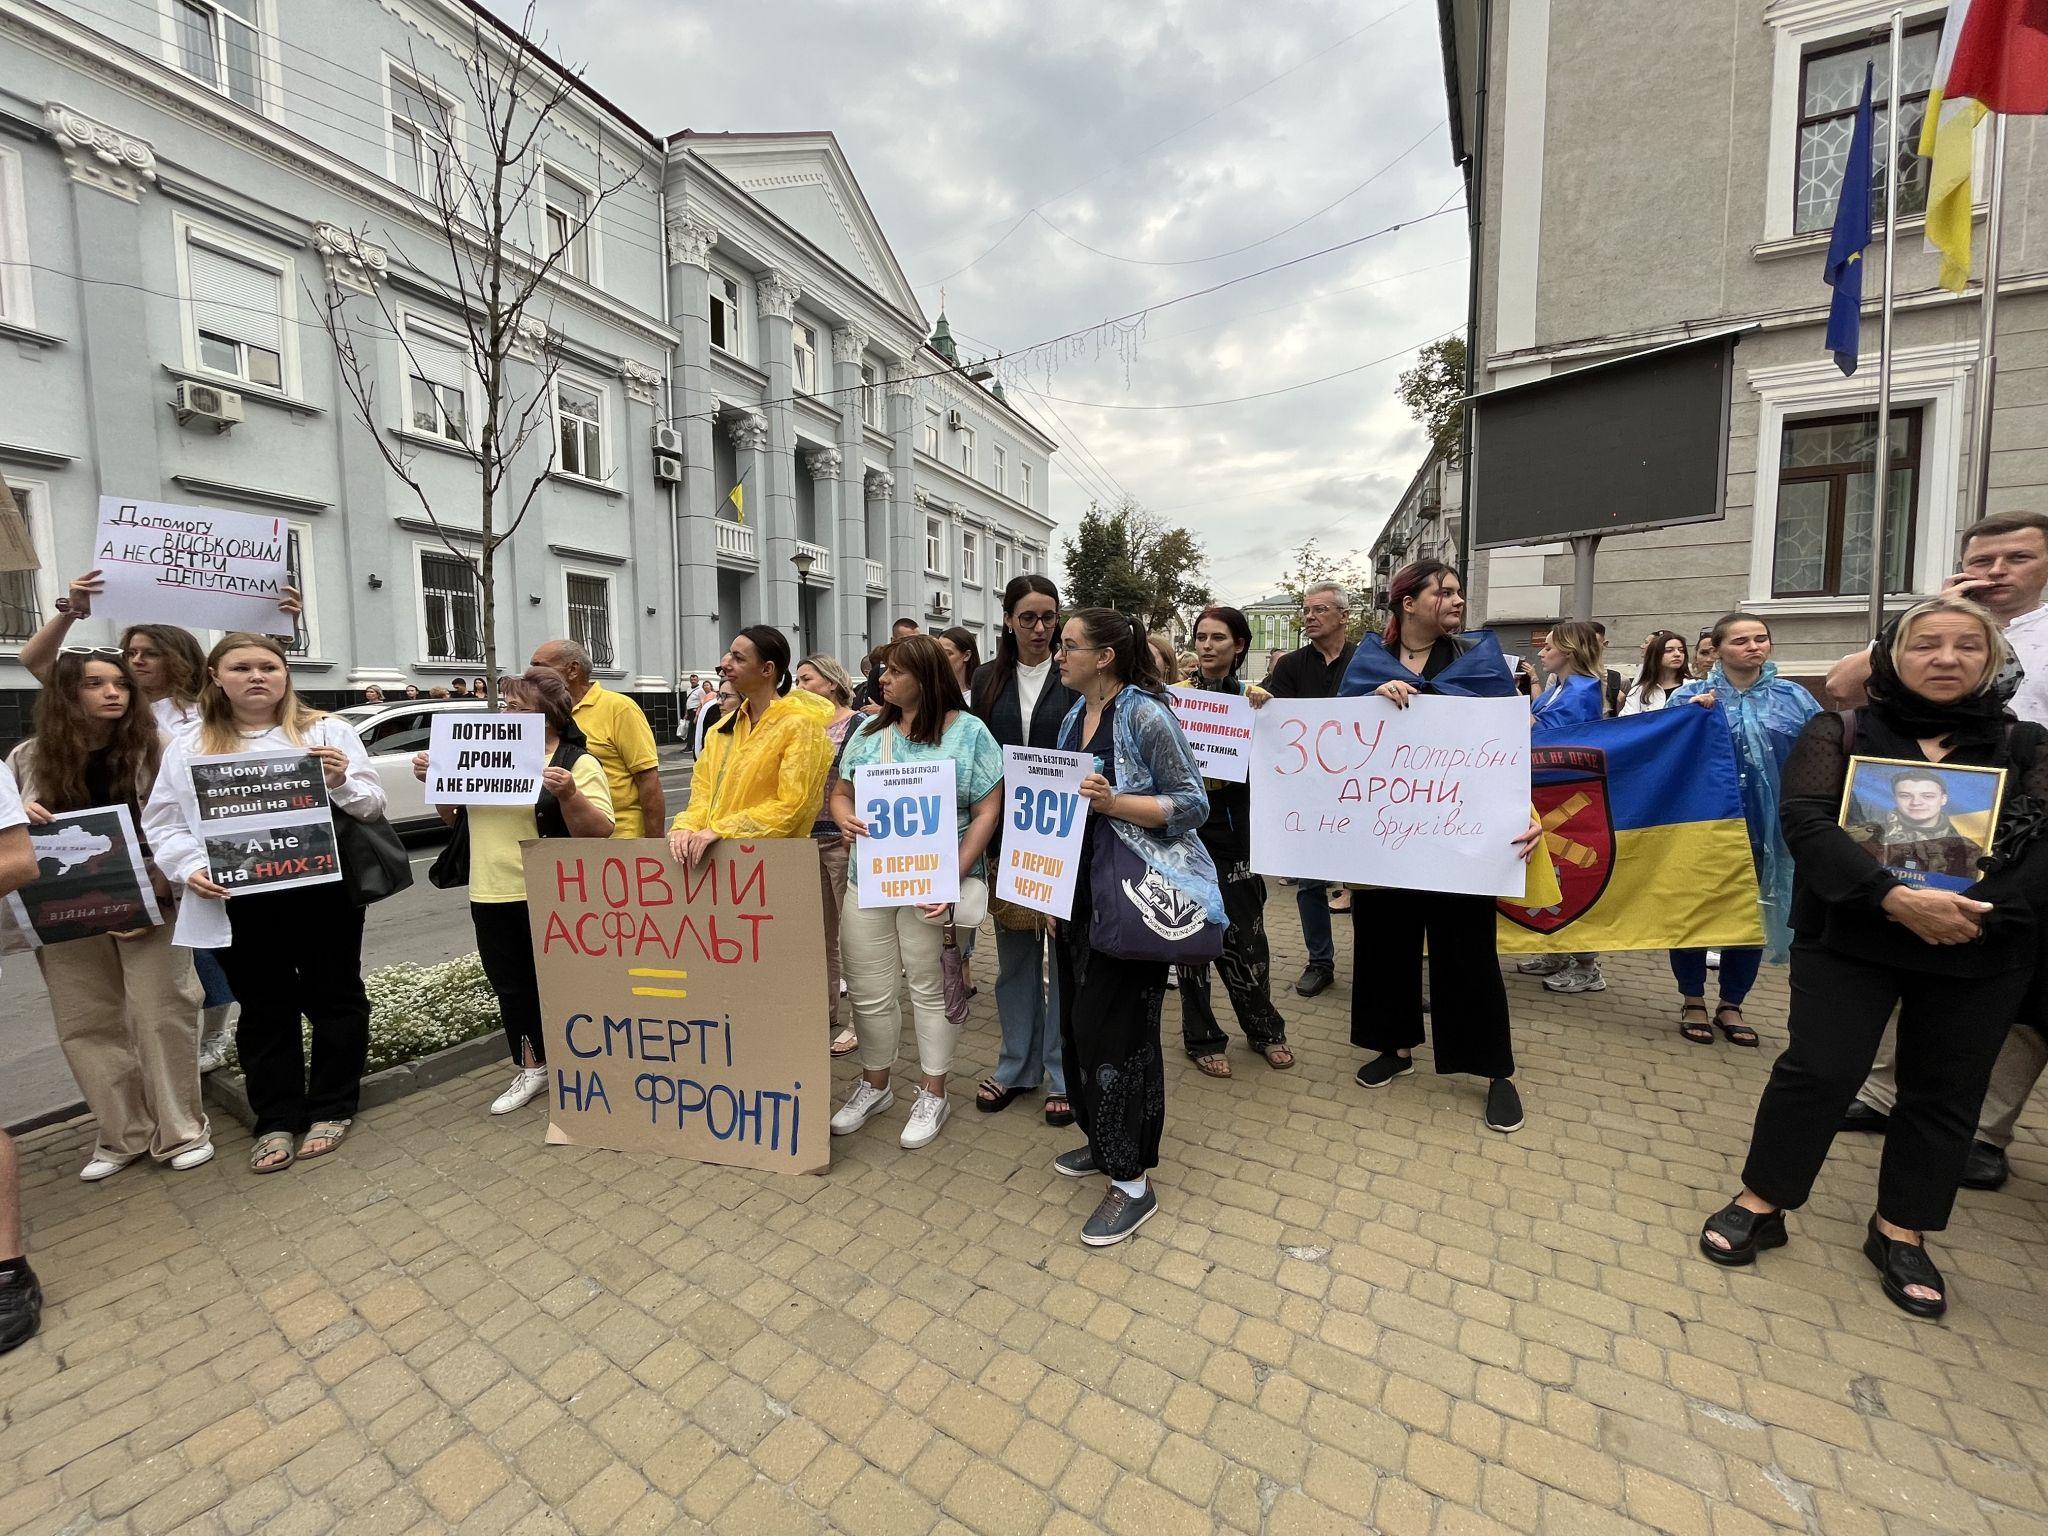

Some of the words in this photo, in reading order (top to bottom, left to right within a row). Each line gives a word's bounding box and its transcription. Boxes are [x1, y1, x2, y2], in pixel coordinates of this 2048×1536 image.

[110, 506, 213, 535] Допомогу
[100, 541, 113, 558] А
[156, 568, 279, 594] ДЕПУТАТАМ
[1184, 699, 1229, 714] ПОТРІБНІ
[452, 723, 522, 741] ПОТРІБНІ
[1274, 719, 1385, 775] ЗСУ
[457, 751, 515, 770] ДРОНИ,
[1013, 752, 1042, 763] ЗУПИНІТЬ
[1043, 754, 1079, 767] БЕЗГЛУЗДІ
[220, 764, 269, 777] Чому
[273, 763, 296, 773] ви
[866, 768, 900, 777] ЗУПИНІТЬ
[902, 765, 940, 775] БЕЗГЛУЗДІ
[207, 779, 311, 798] витрачаєте
[436, 778, 444, 792] А
[447, 778, 463, 792] НЕ
[466, 778, 535, 793] БРУКІВКА!
[210, 800, 262, 817] гроші
[267, 799, 288, 810] на
[867, 795, 941, 840] ЗСУ
[1014, 786, 1079, 838] ЗСУ
[1285, 811, 1306, 832] а
[1318, 814, 1351, 834] не
[246, 838, 264, 854] А
[270, 836, 299, 850] не
[218, 868, 249, 884] на
[255, 857, 310, 879] НИХ
[872, 858, 883, 874] В
[886, 854, 939, 873] ПЕРШУ
[1011, 849, 1020, 867] В
[1022, 852, 1064, 878] ПЕРШУ
[556, 844, 766, 908] НОВИЙ
[881, 878, 931, 897] ЧЕРГУ!
[1014, 876, 1053, 904] ЧЕРГУ!
[104, 904, 131, 914] ТУТ
[543, 910, 773, 964] АСФАЛЬТ
[565, 1013, 732, 1066] СМЕРТІ
[557, 1069, 611, 1113] НА
[635, 1072, 801, 1156] ФРОНТІ
